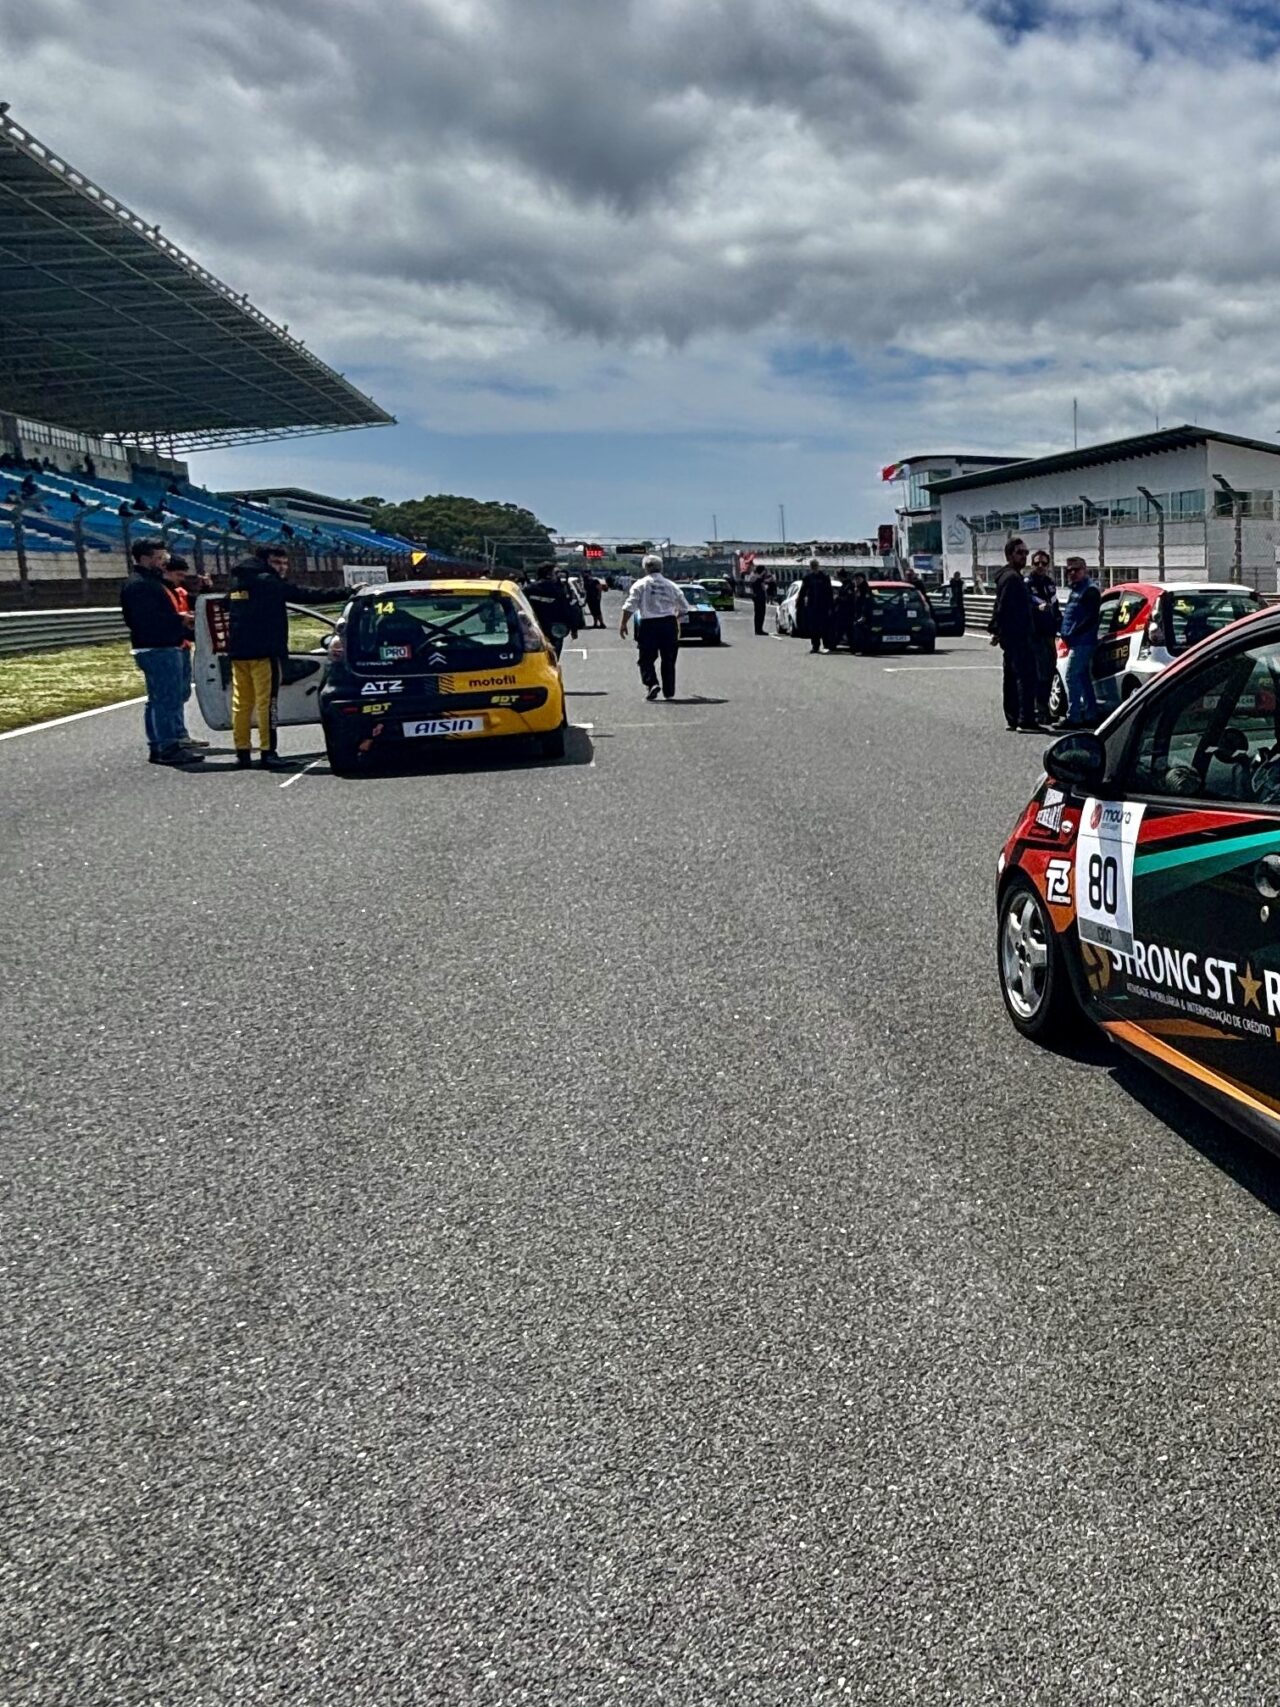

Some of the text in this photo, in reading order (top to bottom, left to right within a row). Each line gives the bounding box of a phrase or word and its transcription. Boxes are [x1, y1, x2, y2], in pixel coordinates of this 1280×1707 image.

[374, 602, 394, 615] 14
[385, 648, 406, 657] PRO
[361, 680, 404, 692] ATZ
[469, 675, 516, 687] motofil
[415, 716, 473, 735] AISIN
[1088, 853, 1118, 915] 80
[1232, 1015, 1243, 1028] DE
